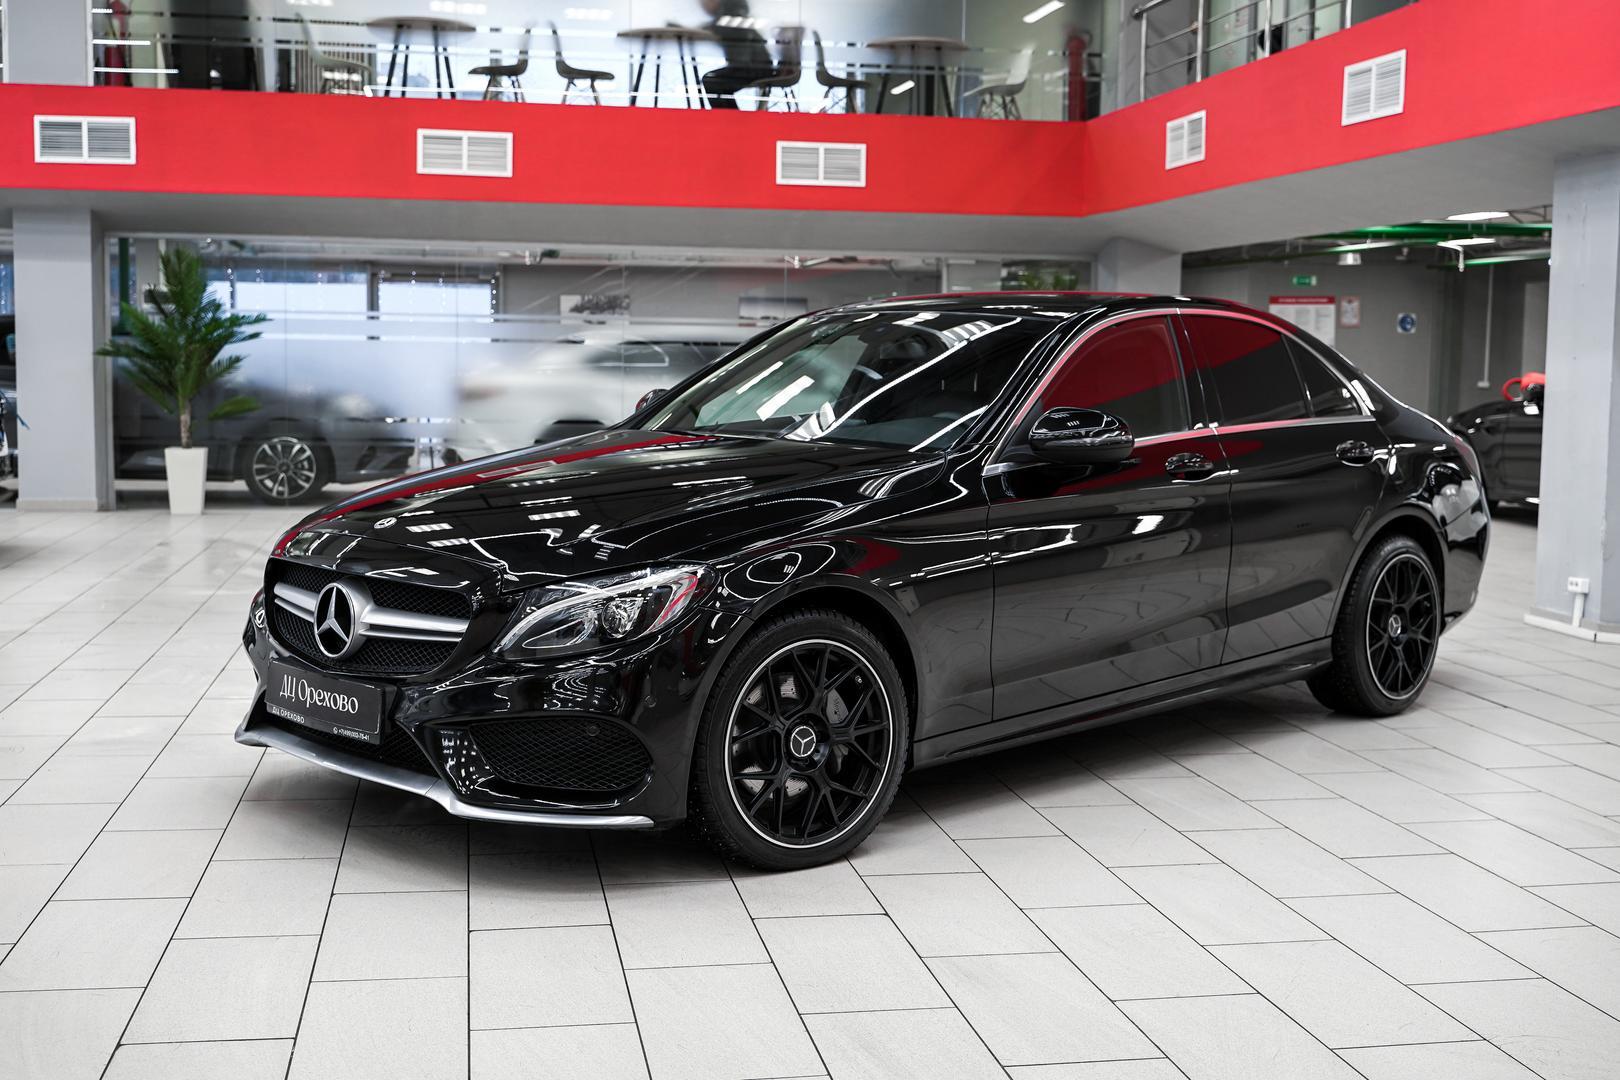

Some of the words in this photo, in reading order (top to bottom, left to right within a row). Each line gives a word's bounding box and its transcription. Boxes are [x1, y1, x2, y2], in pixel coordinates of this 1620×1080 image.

[280, 674, 296, 702] ДЦ
[298, 679, 359, 714] Орехово
[280, 707, 305, 724] ОРЕХОВО
